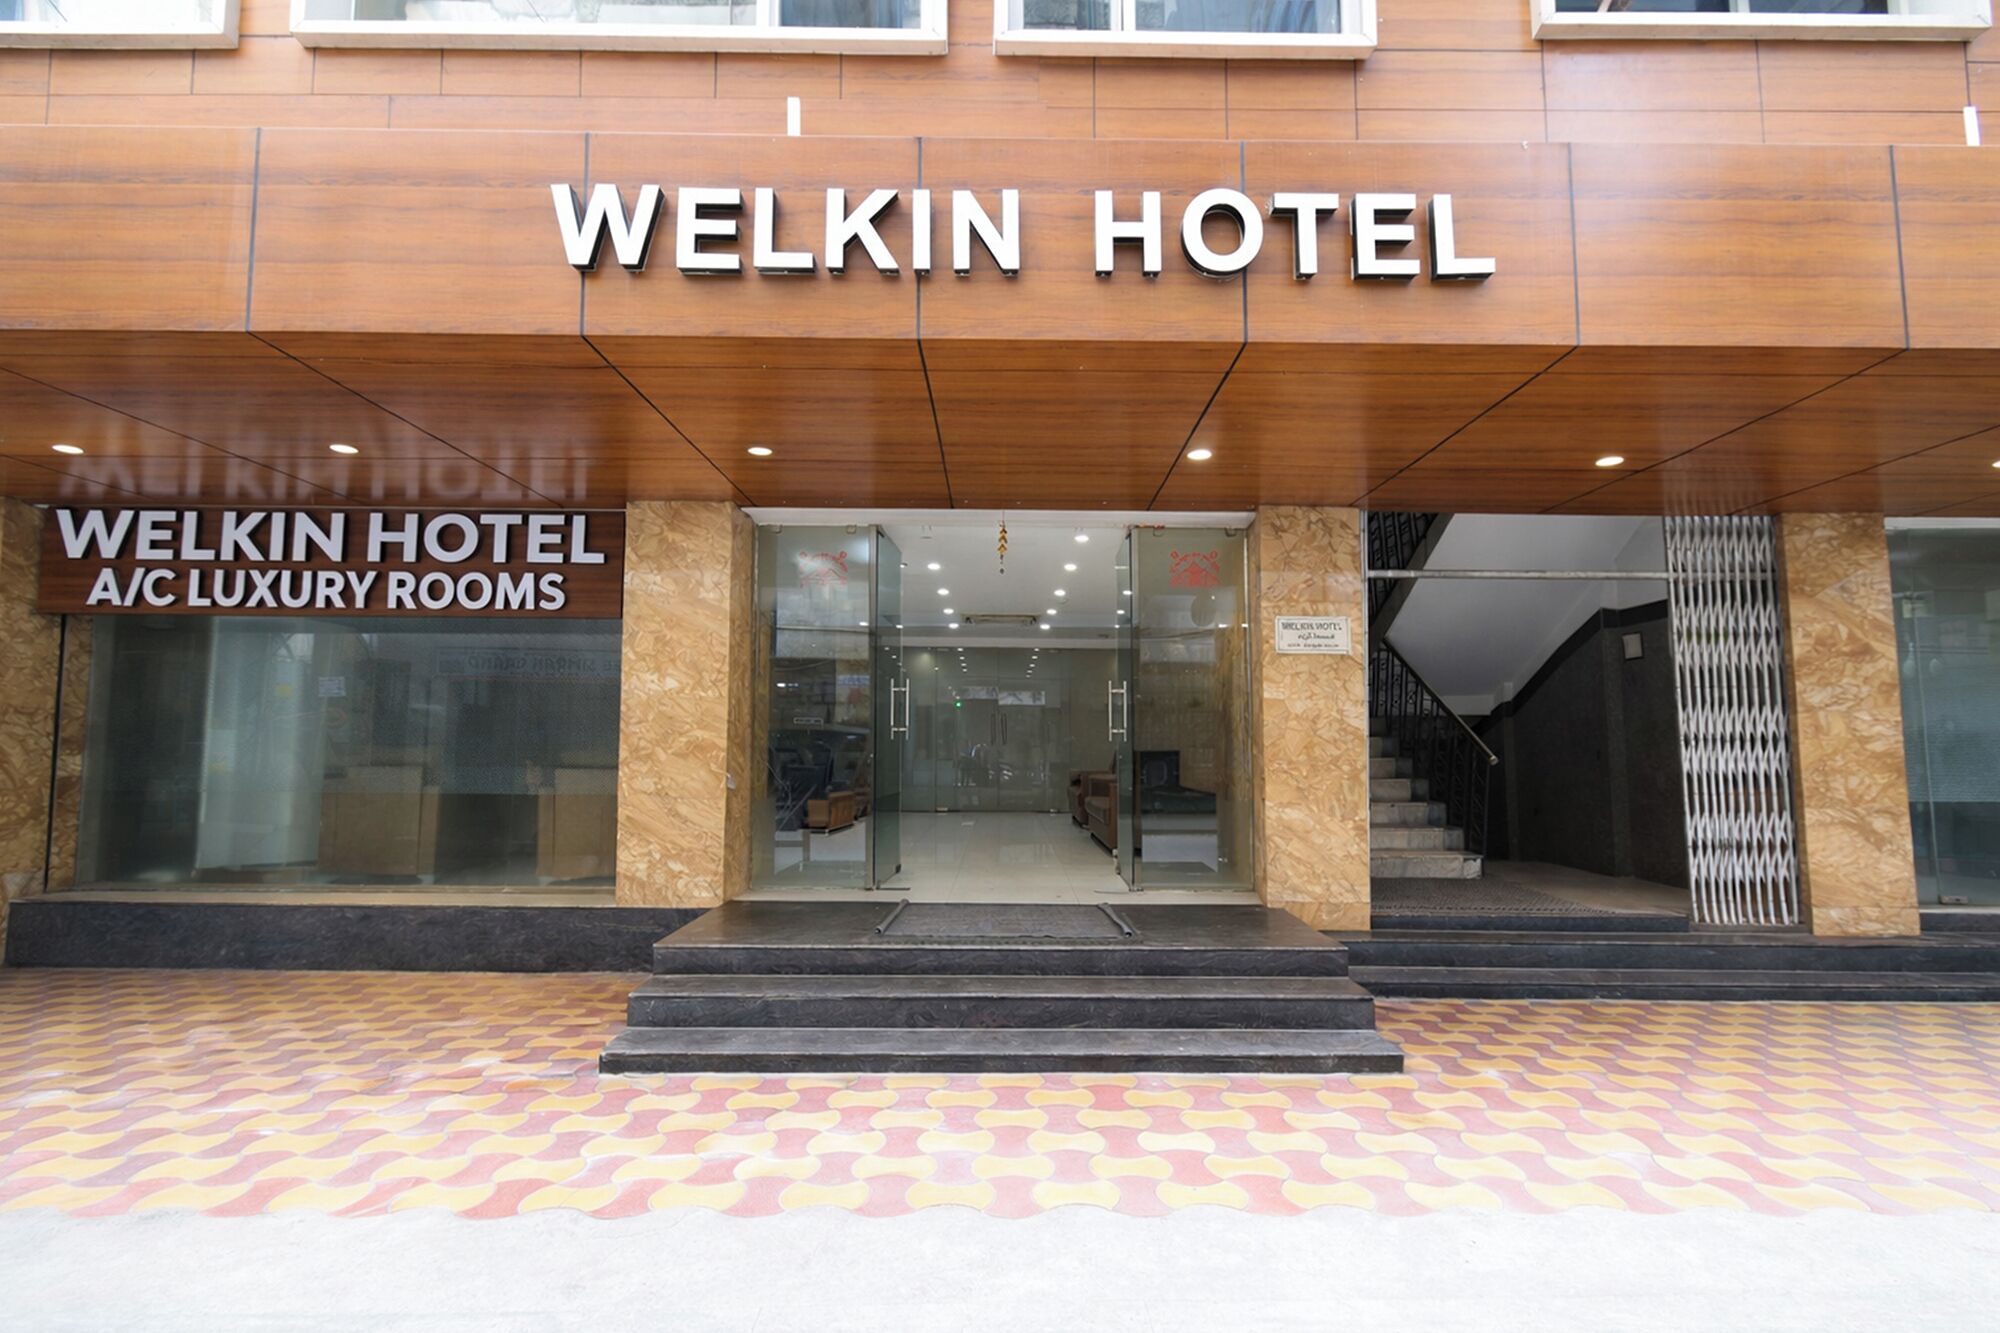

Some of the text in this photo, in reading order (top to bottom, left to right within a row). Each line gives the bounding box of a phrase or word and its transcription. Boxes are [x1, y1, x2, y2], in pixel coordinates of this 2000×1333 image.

[550, 183, 1496, 281] WELKIN HOTEL
[56, 508, 606, 564] WELKIN HOTEL
[85, 567, 567, 611] A/C LUXURY ROOMS
